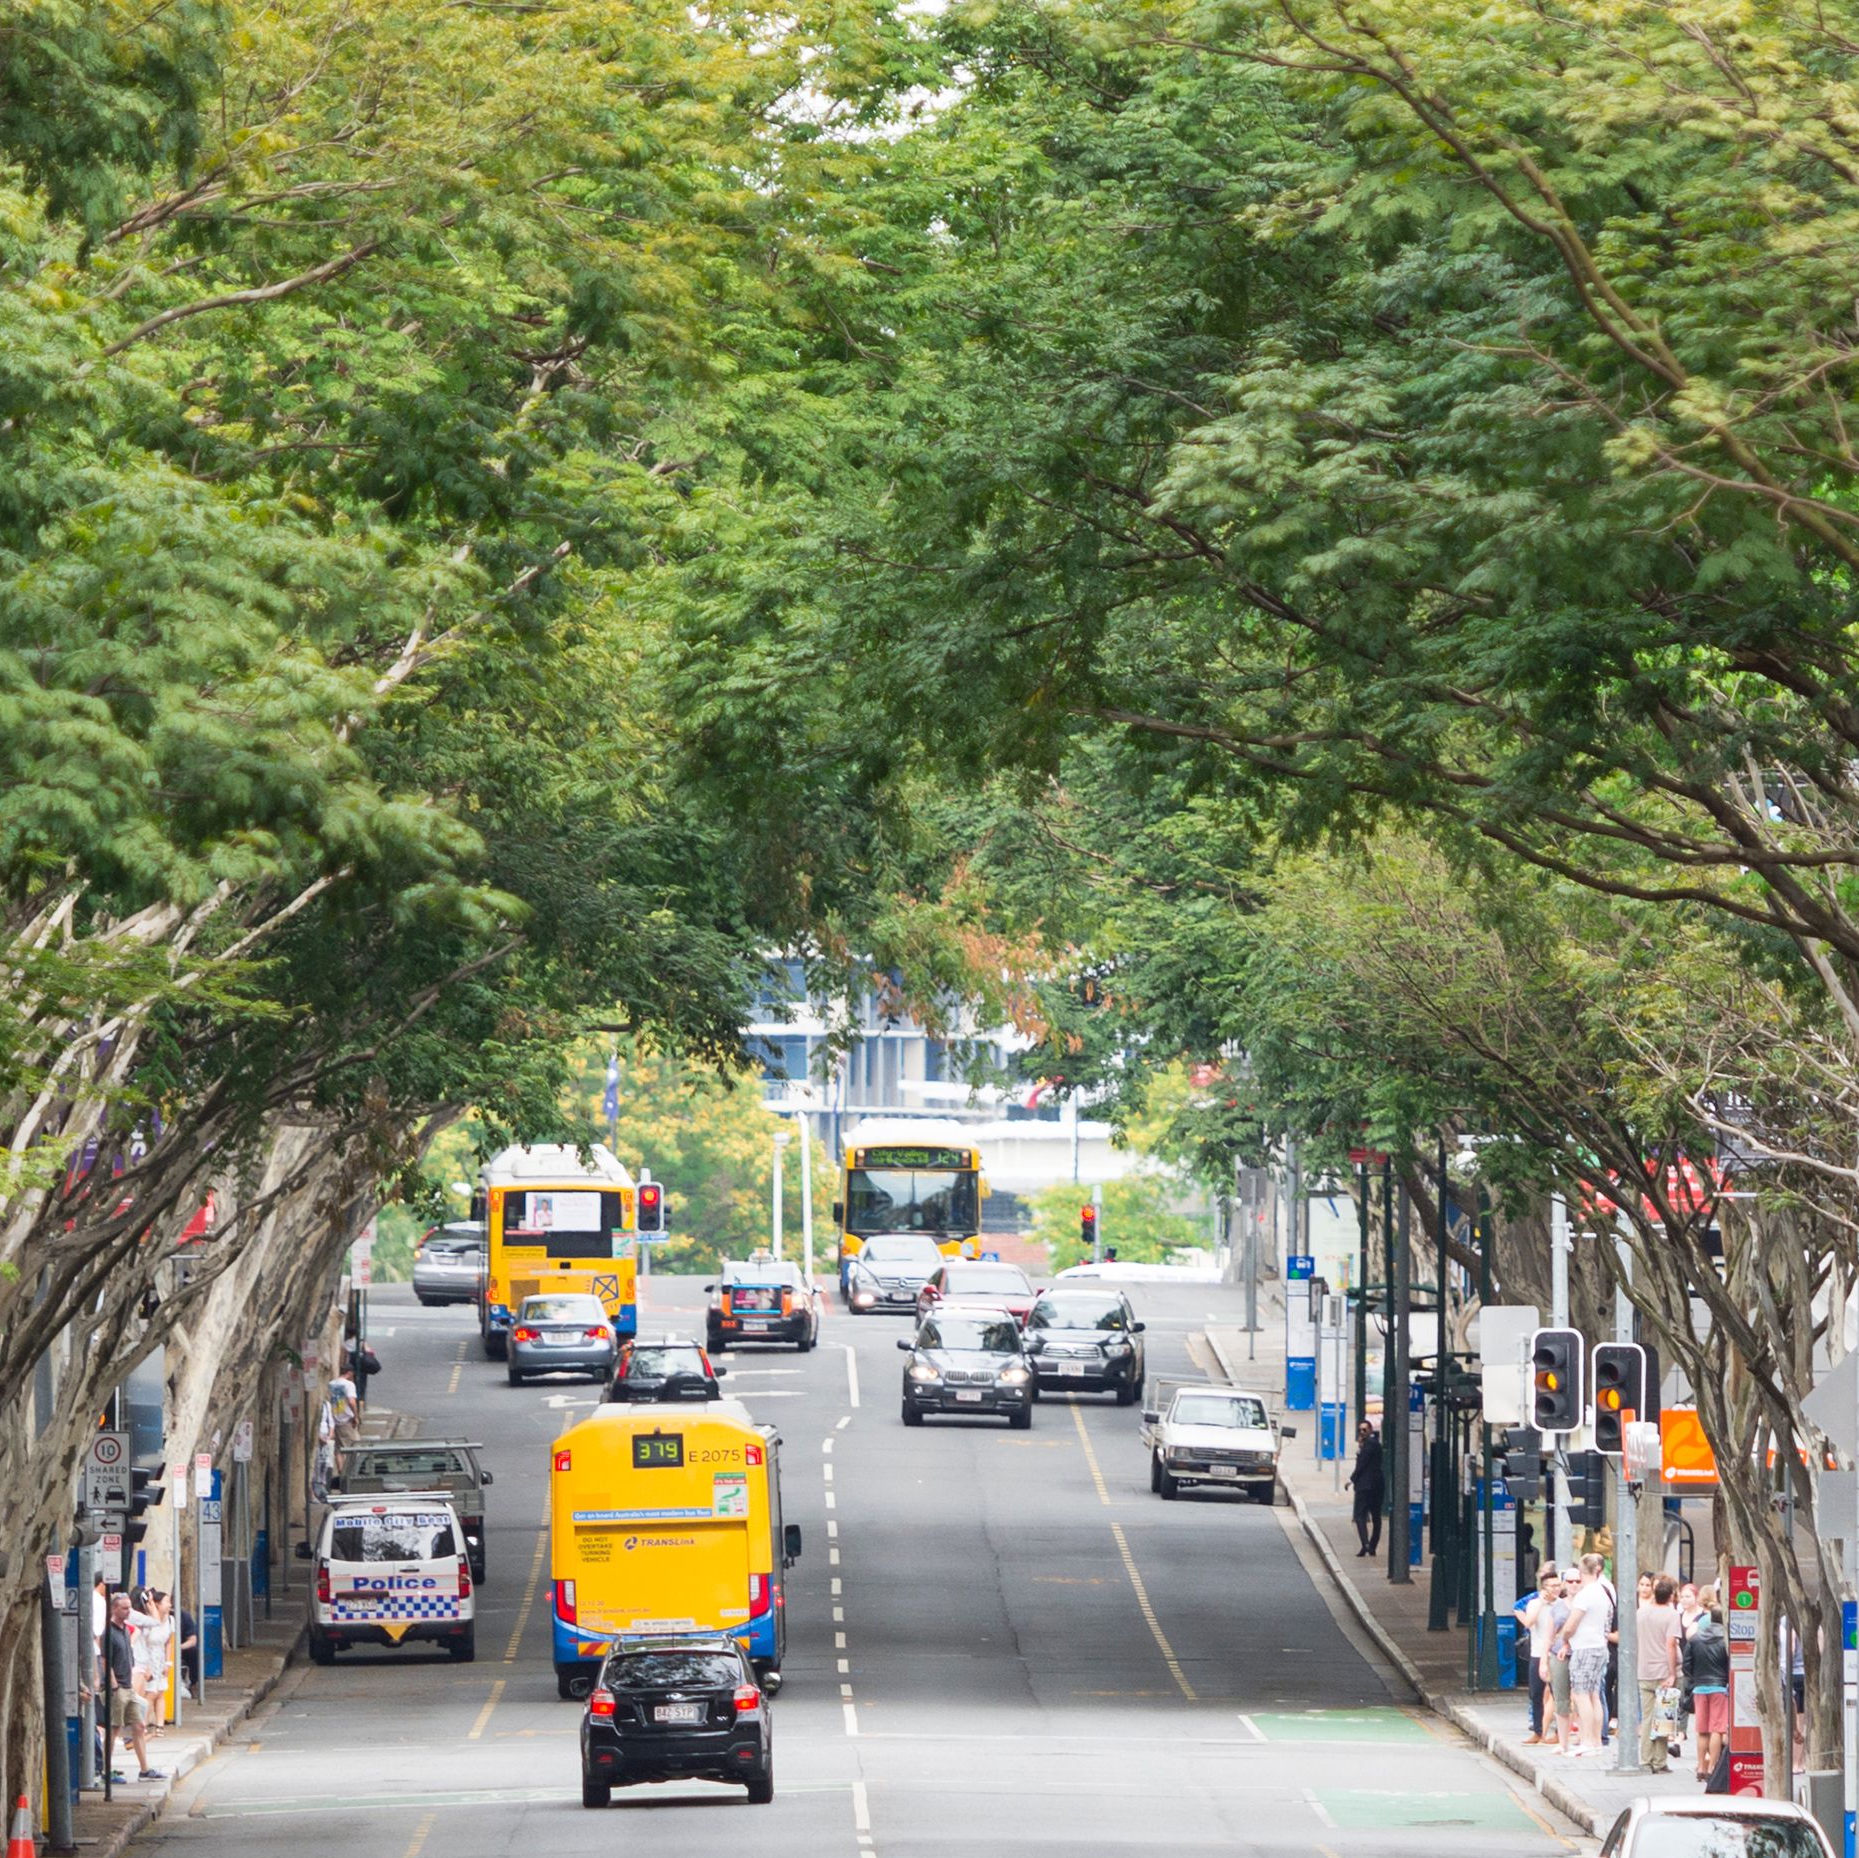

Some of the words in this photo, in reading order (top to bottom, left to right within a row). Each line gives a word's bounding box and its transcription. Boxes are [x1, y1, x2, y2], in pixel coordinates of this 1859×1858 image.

[100, 1444, 116, 1456] 10
[639, 1442, 678, 1459] 379
[702, 1450, 740, 1462] 2075
[89, 1466, 127, 1474] SHARED
[95, 1476, 120, 1484] ZONE
[203, 1502, 221, 1520] 43
[334, 1517, 382, 1528] Mobile
[383, 1515, 414, 1527] City
[417, 1514, 451, 1526] Beat
[352, 1575, 437, 1590] Police
[1730, 1622, 1755, 1637] Stop
